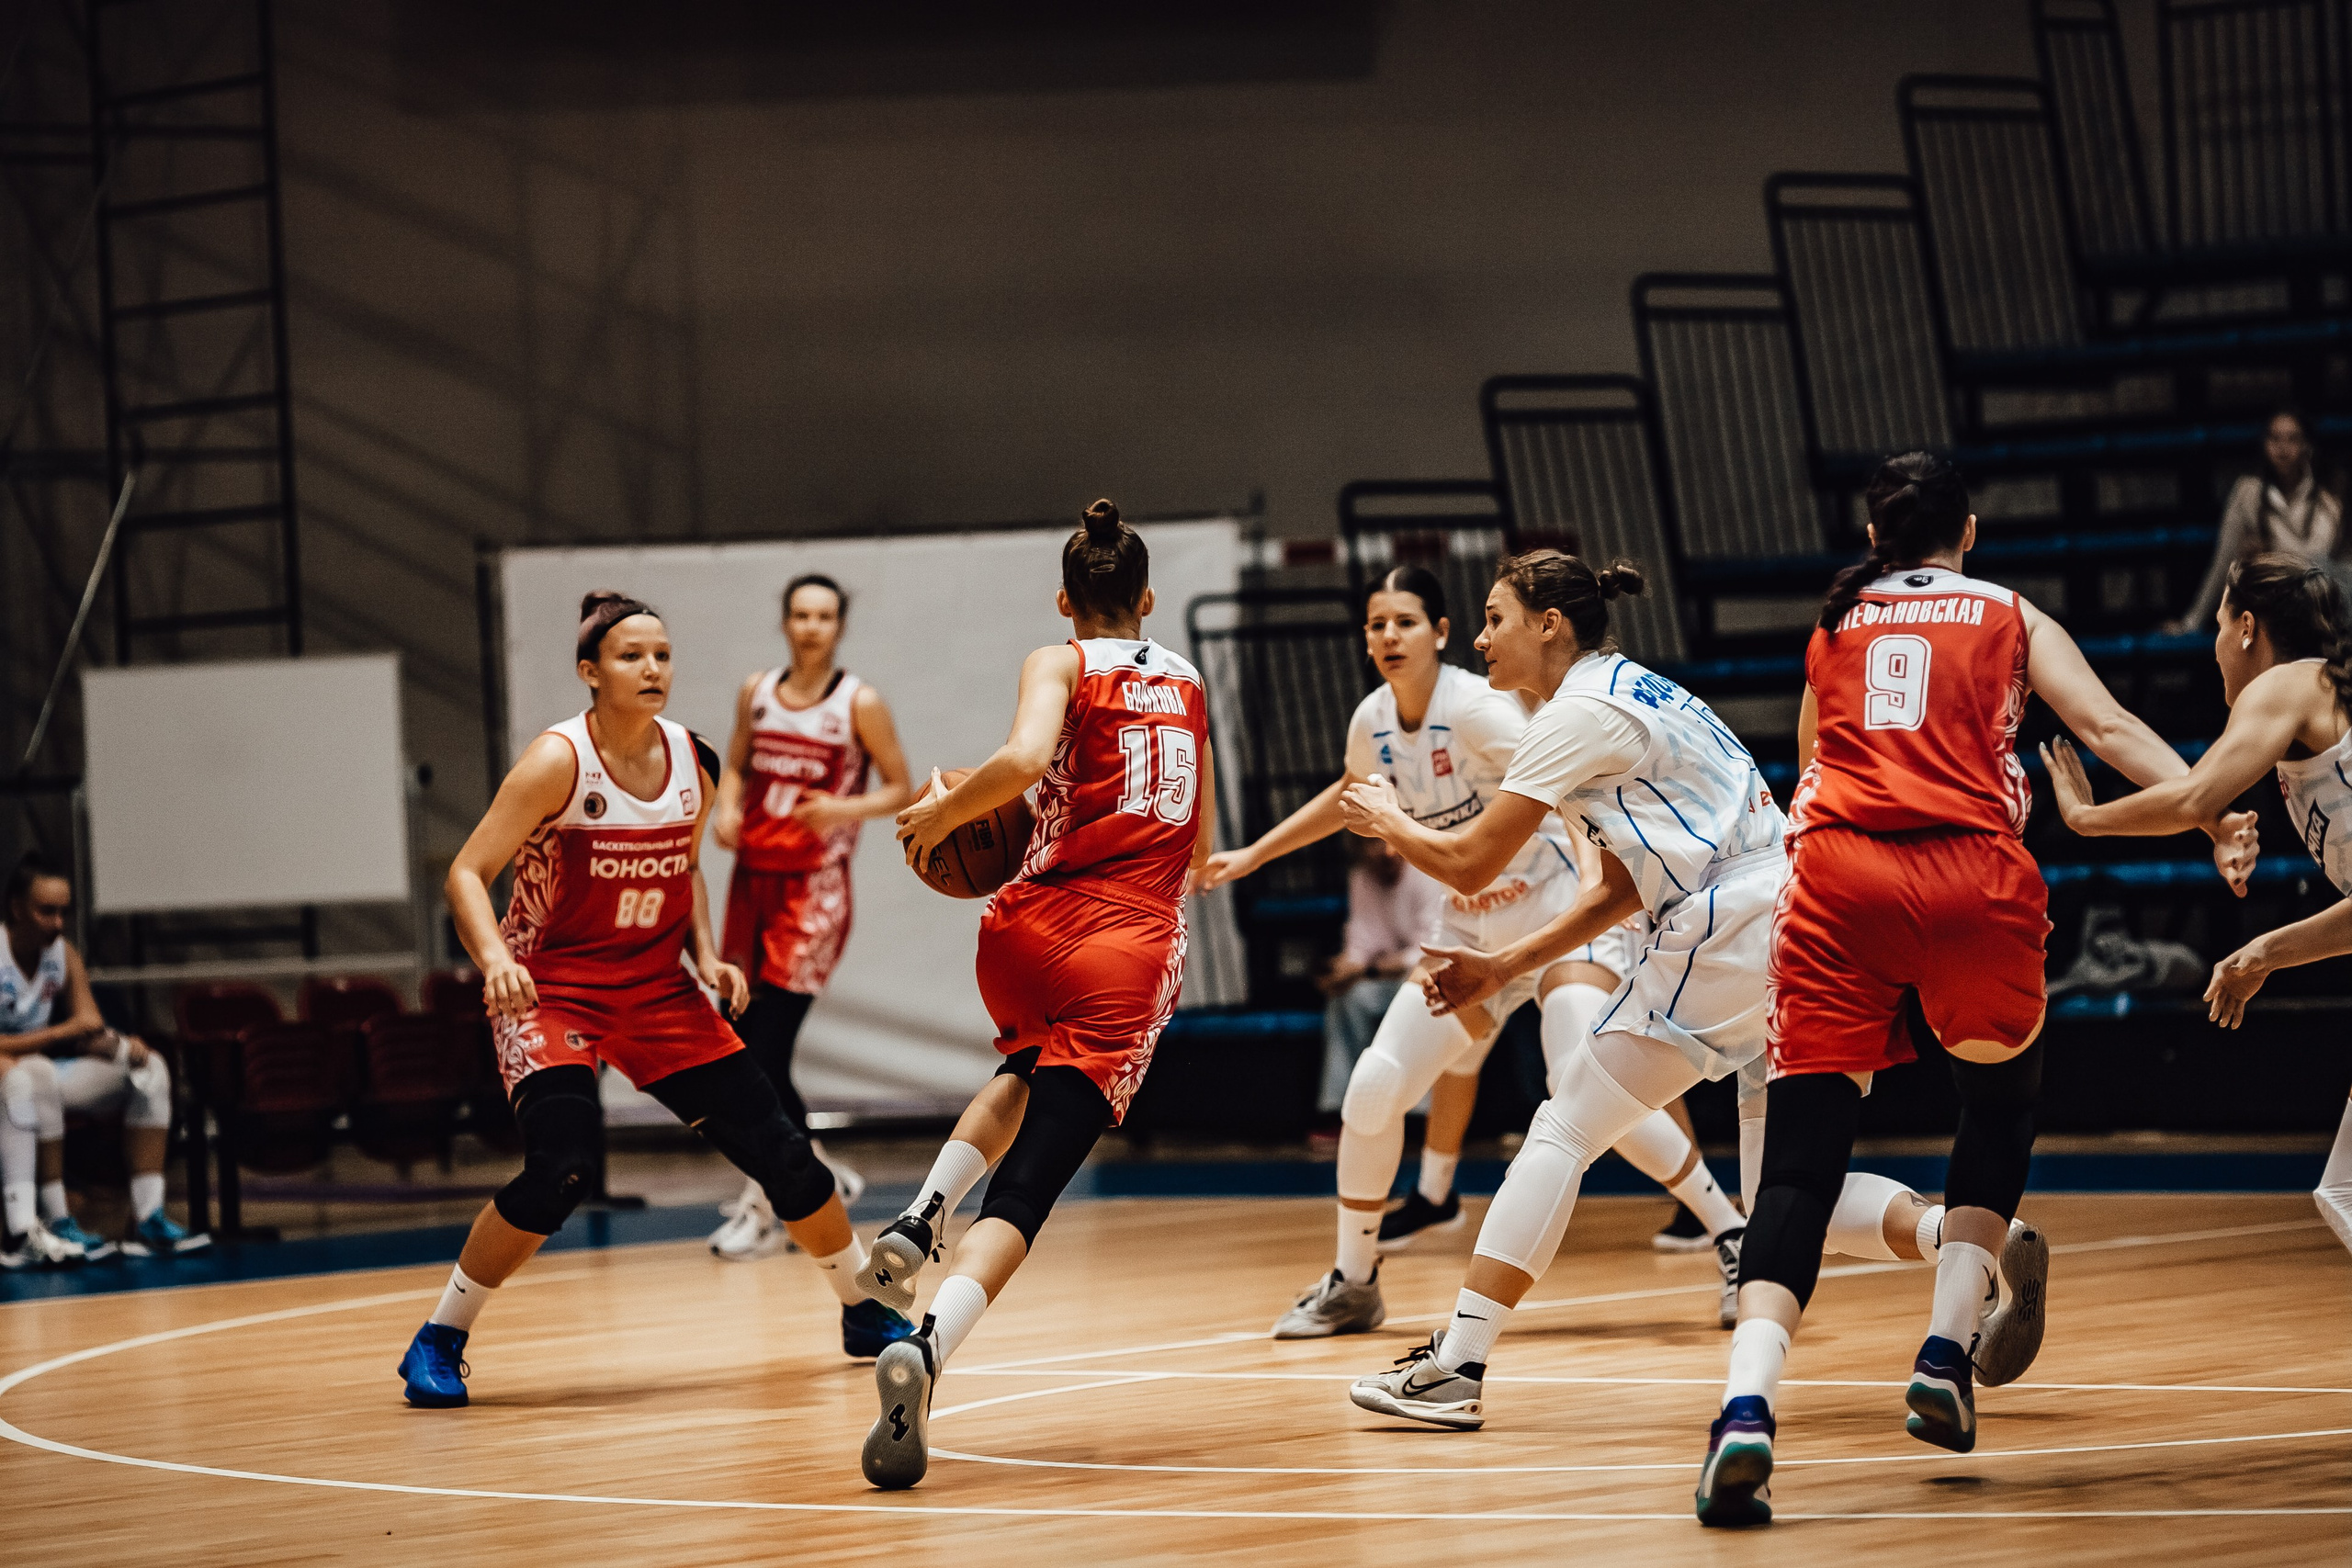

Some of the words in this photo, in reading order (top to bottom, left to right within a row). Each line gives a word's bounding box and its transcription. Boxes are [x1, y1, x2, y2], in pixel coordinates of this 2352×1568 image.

[1835, 598, 1984, 633] ЕФАНОВСКАЯ
[1121, 680, 1187, 716] БОЙКОВА
[1864, 634, 1932, 731] 9
[1115, 724, 1197, 827] 15
[615, 887, 666, 929] 88
